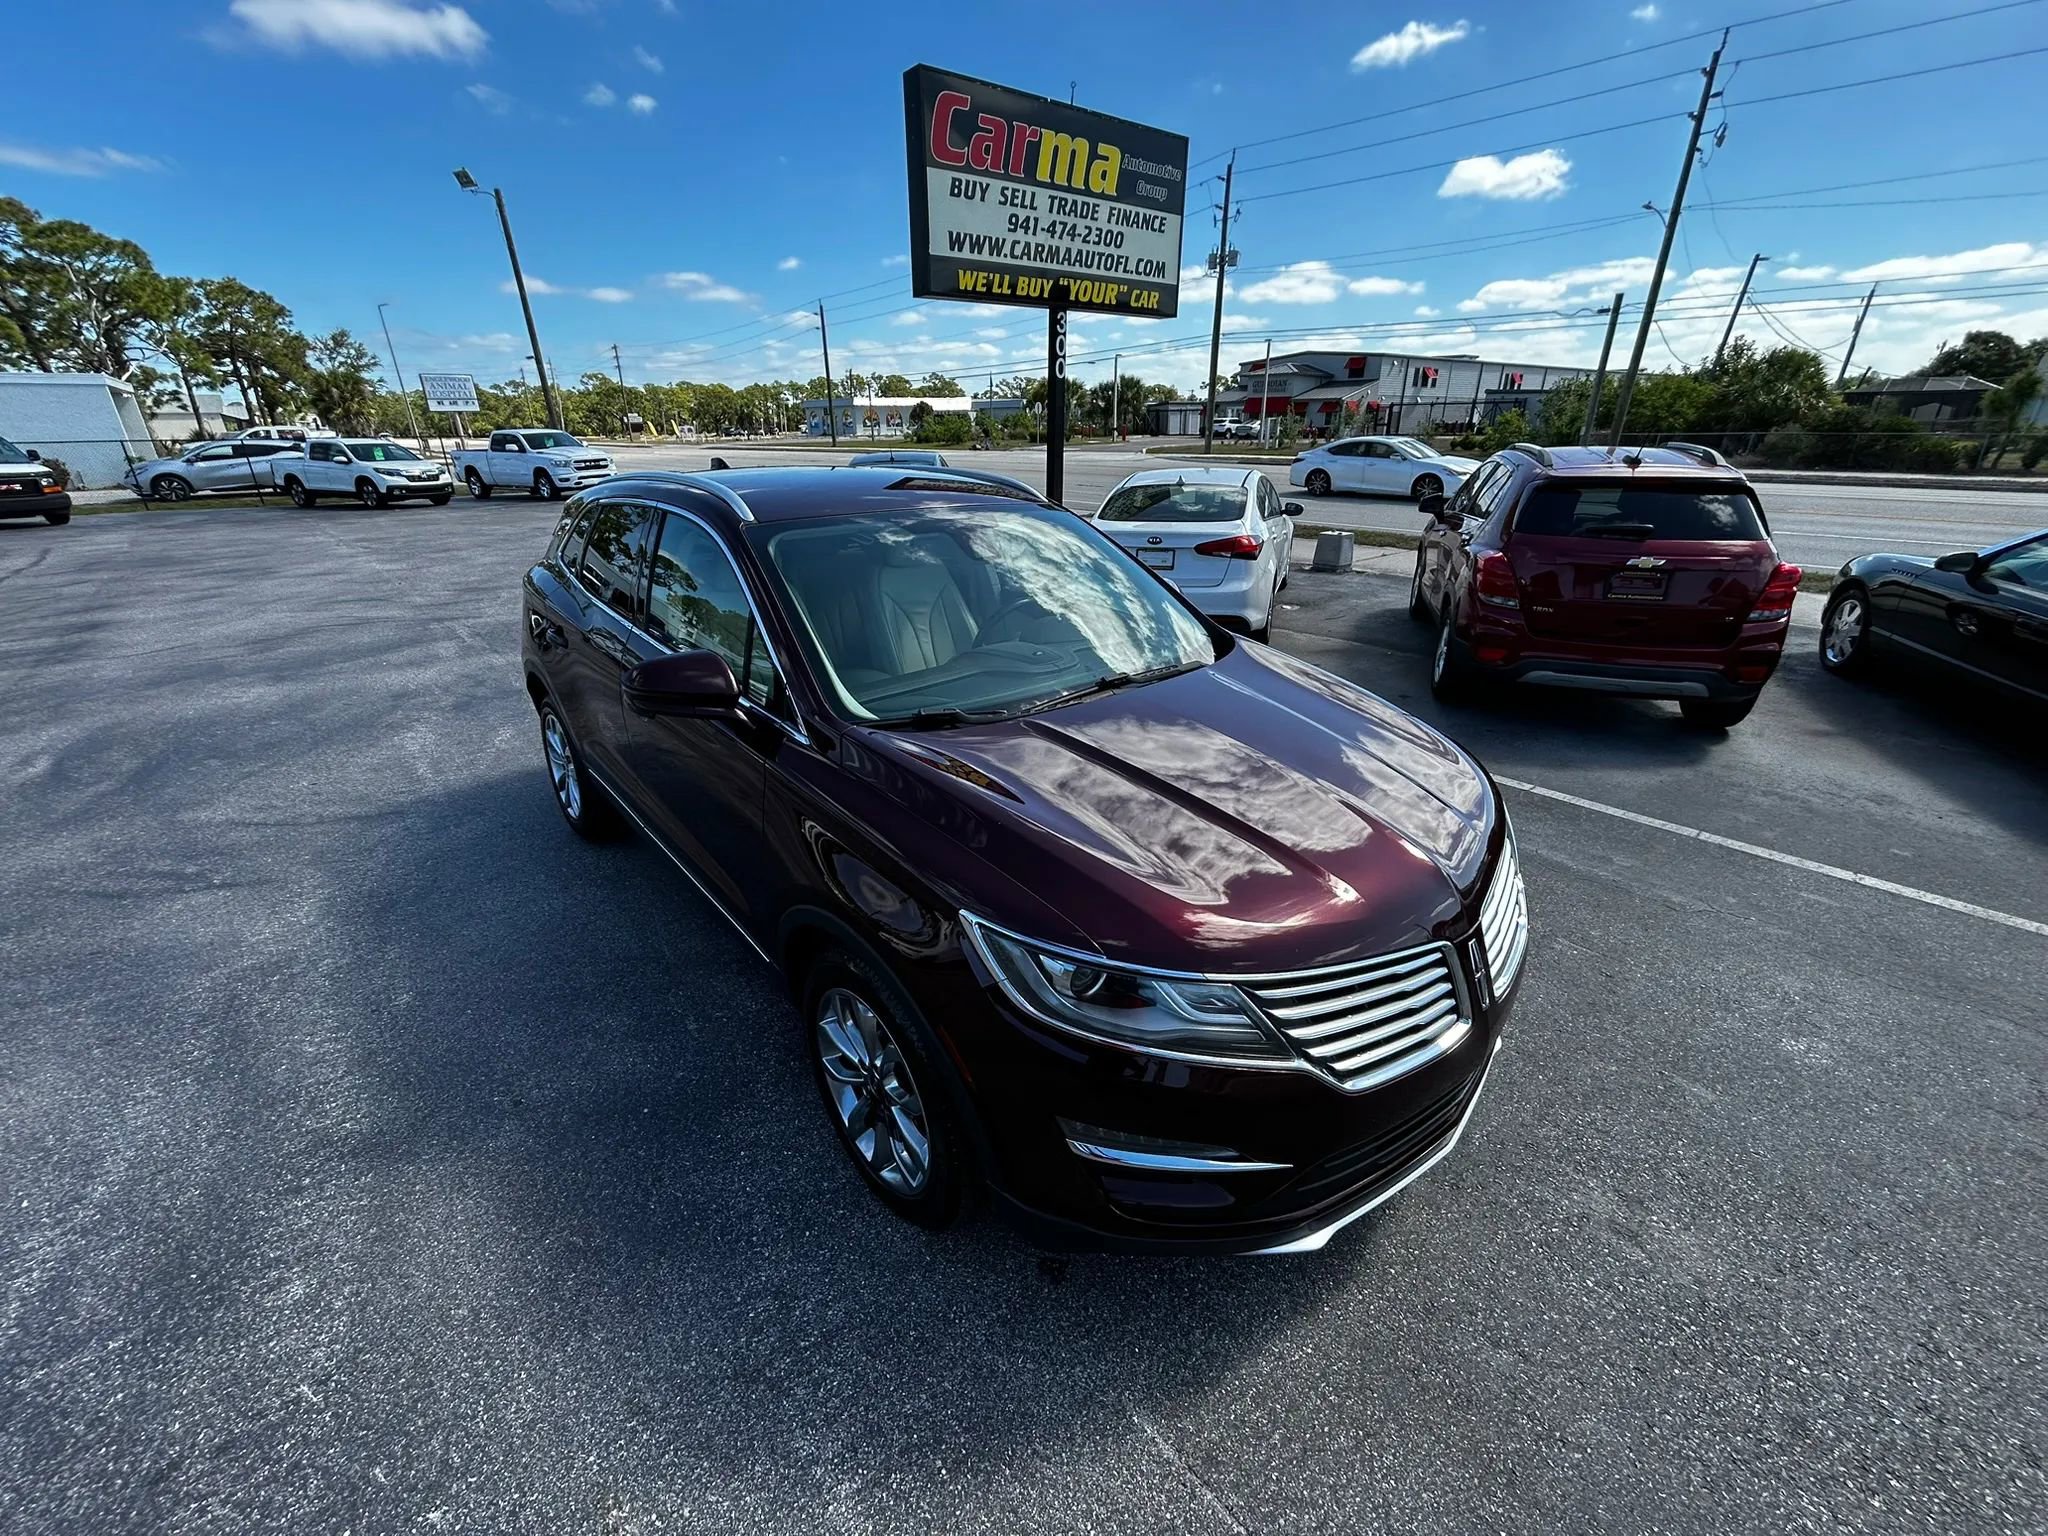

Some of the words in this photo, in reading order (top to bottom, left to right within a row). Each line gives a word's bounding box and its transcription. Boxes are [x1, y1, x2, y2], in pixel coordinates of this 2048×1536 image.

[930, 90, 1122, 197] Carma
[1122, 154, 1183, 182] Automotive
[949, 176, 991, 202] BUY
[998, 185, 1038, 212] SELL
[1048, 195, 1101, 222] TRADE
[1106, 205, 1168, 234] FINANCE
[1136, 179, 1168, 202] Group
[1007, 212, 1125, 249] 941-474-2300
[947, 230, 1167, 279] WWW.CARMAAUTOFL.COM
[957, 268, 1012, 296] WE'LL
[1016, 275, 1054, 298] BUY
[1130, 289, 1160, 309] CAR
[1055, 311, 1067, 378] 300
[427, 390, 473, 398] HOSPITAL
[430, 382, 470, 390] ANIMAL
